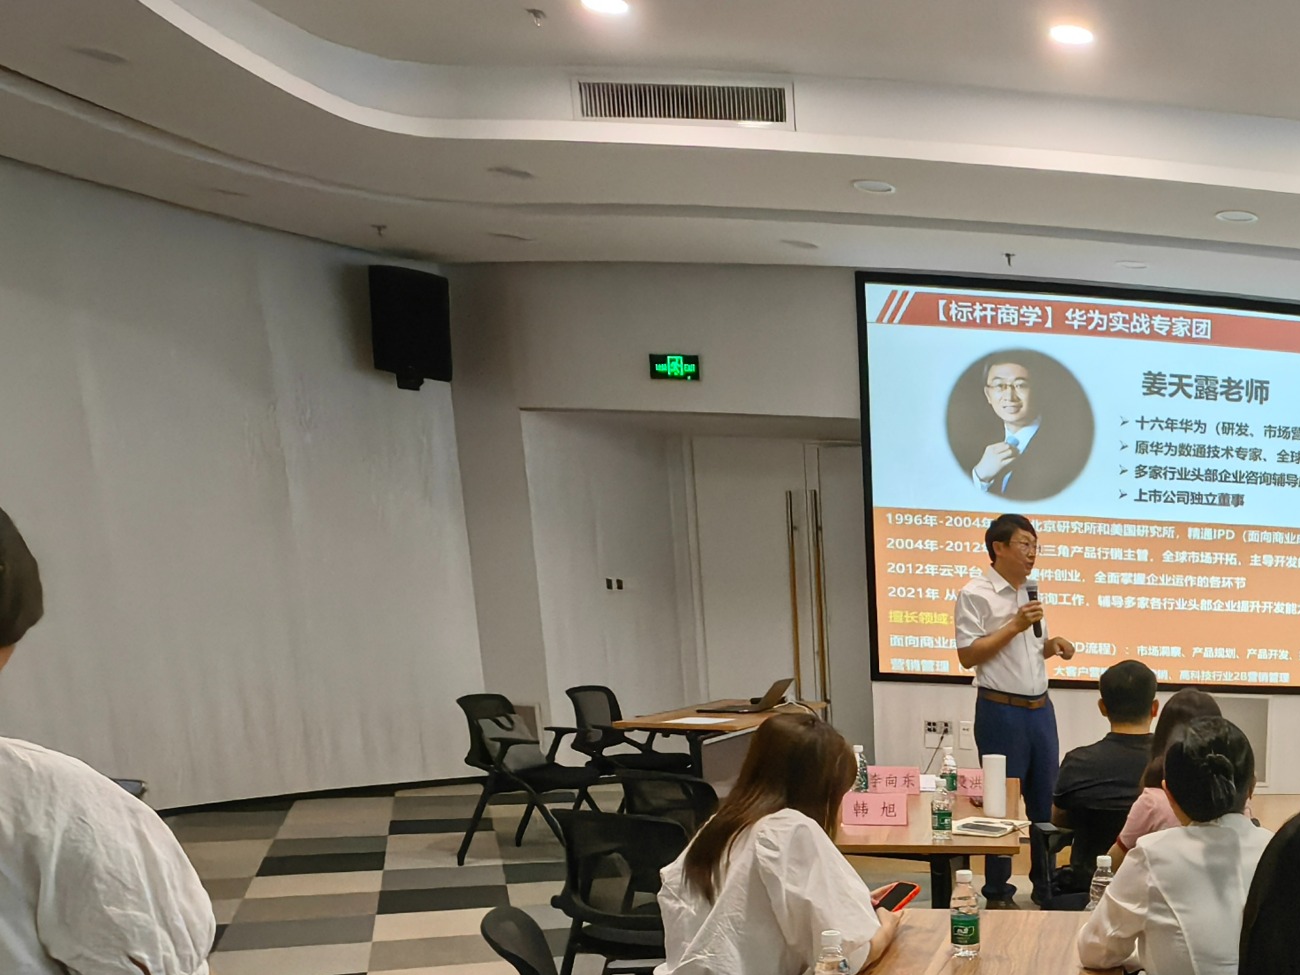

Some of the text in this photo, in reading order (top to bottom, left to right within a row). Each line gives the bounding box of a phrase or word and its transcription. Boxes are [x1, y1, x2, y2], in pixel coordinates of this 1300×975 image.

[936, 301, 1212, 340] 【标杆商学】华为实战专家团
[1141, 370, 1271, 406] 姜天露老师
[1133, 488, 1246, 508] 上市公司独立董事
[885, 537, 989, 553] 2004年-2012
